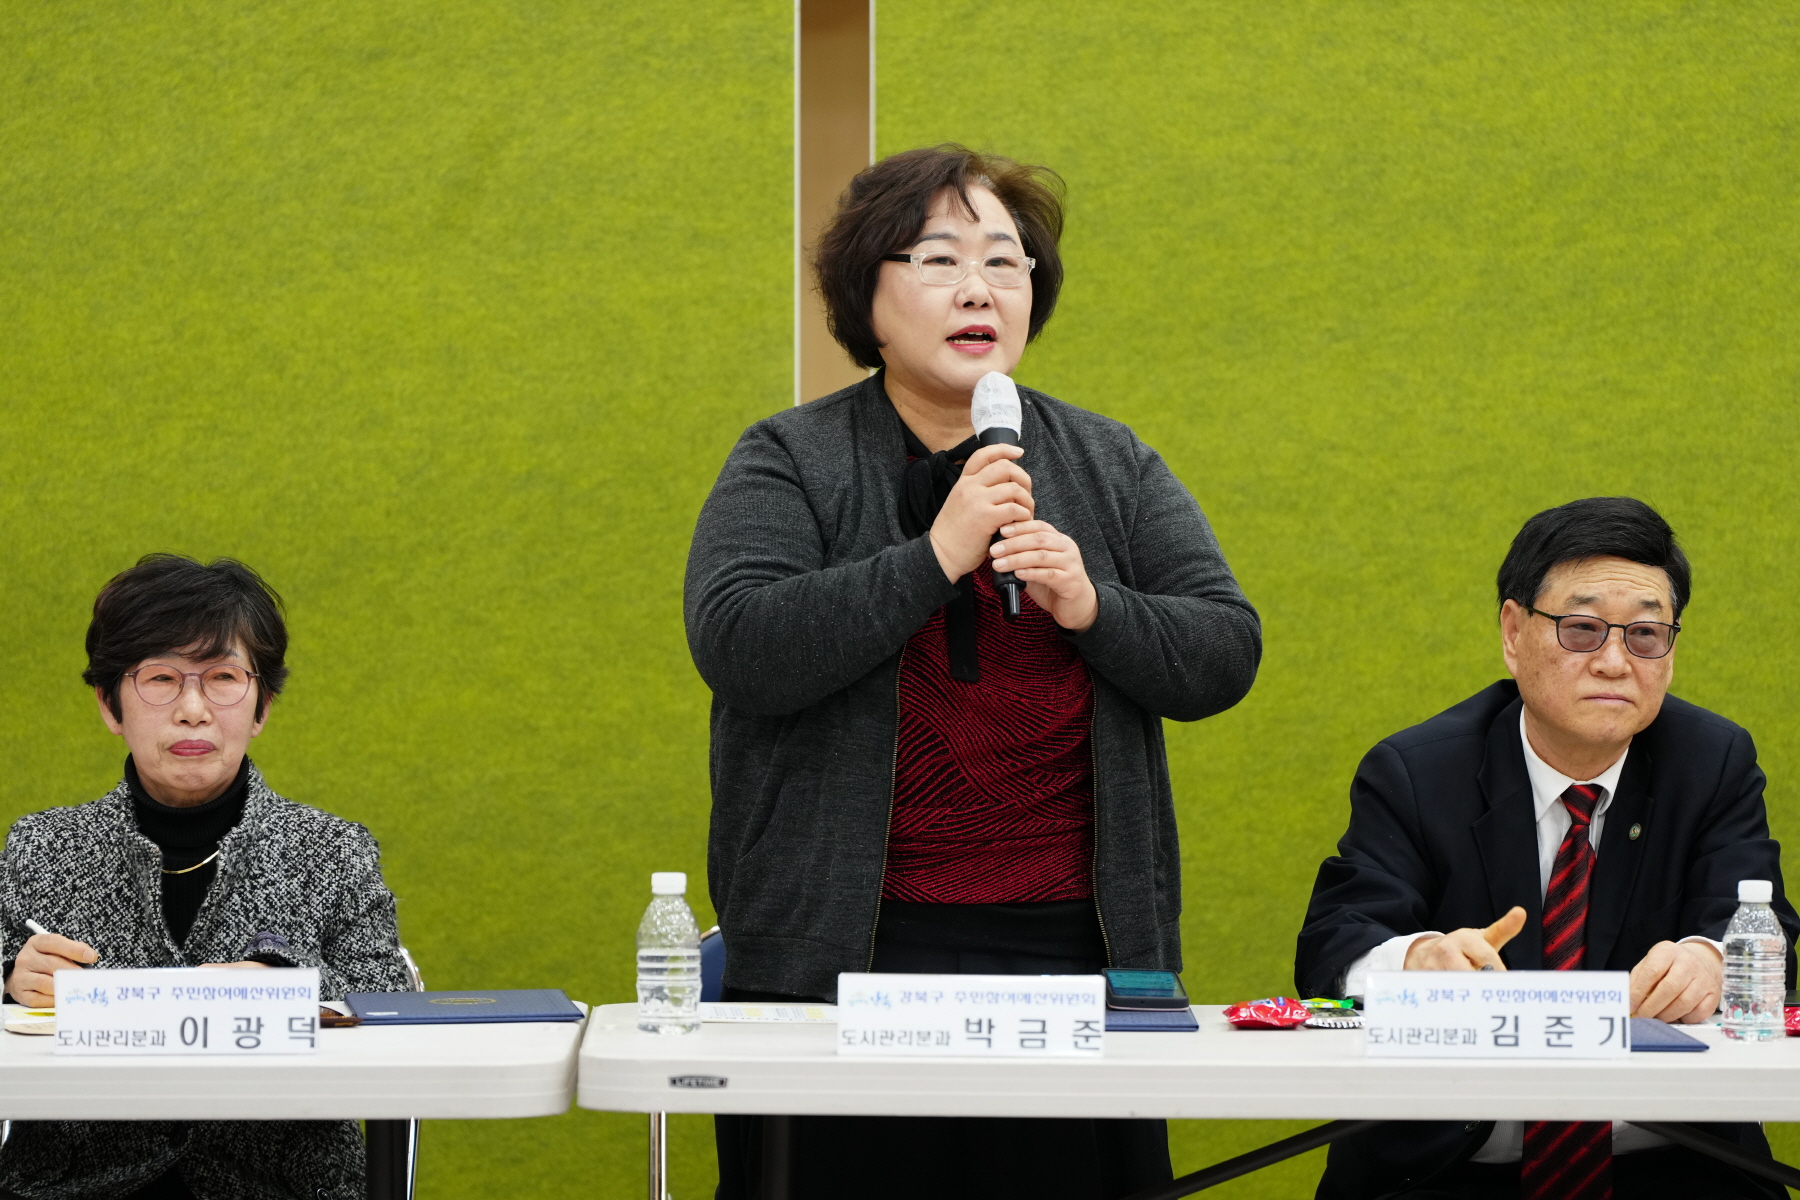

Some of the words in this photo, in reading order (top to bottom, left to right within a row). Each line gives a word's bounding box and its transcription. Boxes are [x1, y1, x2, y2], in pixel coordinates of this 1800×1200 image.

[116, 986, 161, 1000] 강북구
[171, 986, 312, 1000] 주민참여예산위원회
[900, 991, 944, 1004] 강북구
[955, 991, 1096, 1005] 주민참여예산위원회
[1425, 989, 1471, 1002] 강북구
[1481, 989, 1622, 1003] 주민참여예산위원회
[58, 1030, 166, 1047] 도시관리분과
[842, 1029, 950, 1047] 도시관리분과
[1368, 1027, 1477, 1045] 도시관리분과
